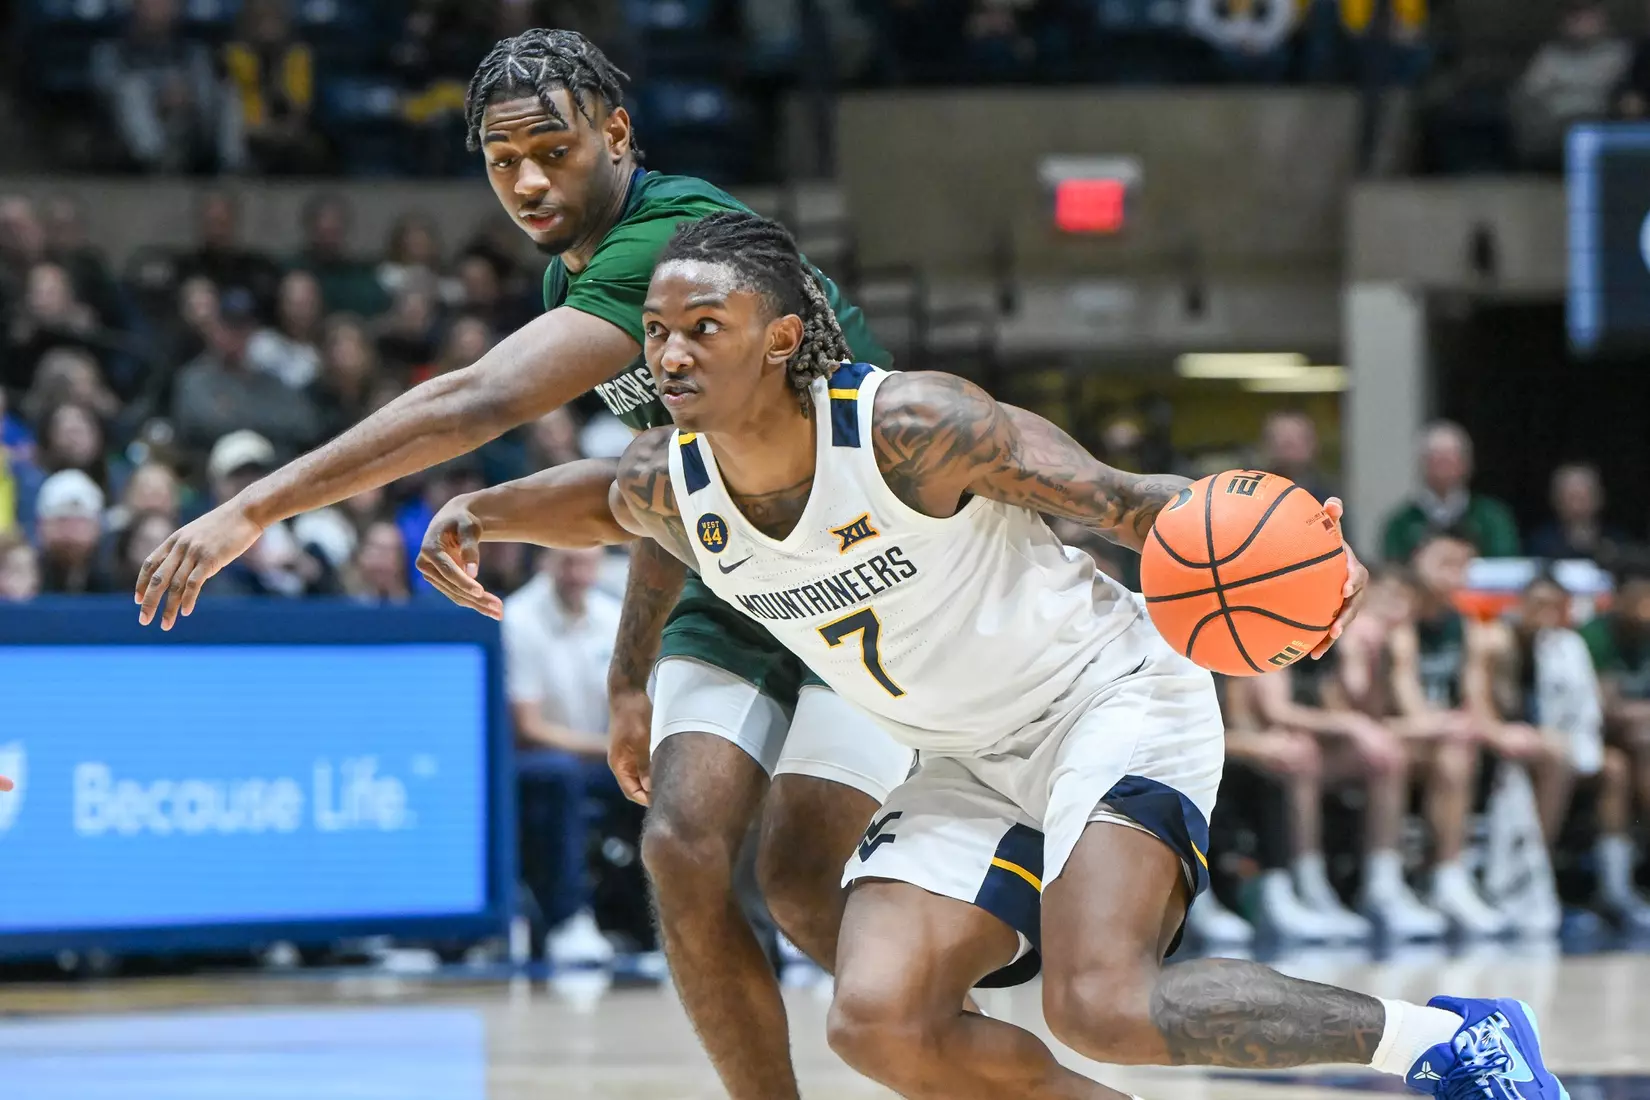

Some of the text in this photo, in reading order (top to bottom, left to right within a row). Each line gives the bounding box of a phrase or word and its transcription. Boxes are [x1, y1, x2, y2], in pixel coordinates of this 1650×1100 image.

[701, 520, 720, 529] WEST
[702, 527, 723, 546] 44
[735, 546, 917, 620] MOUNTAINEERS
[816, 606, 907, 698] 7
[74, 761, 303, 837] Because
